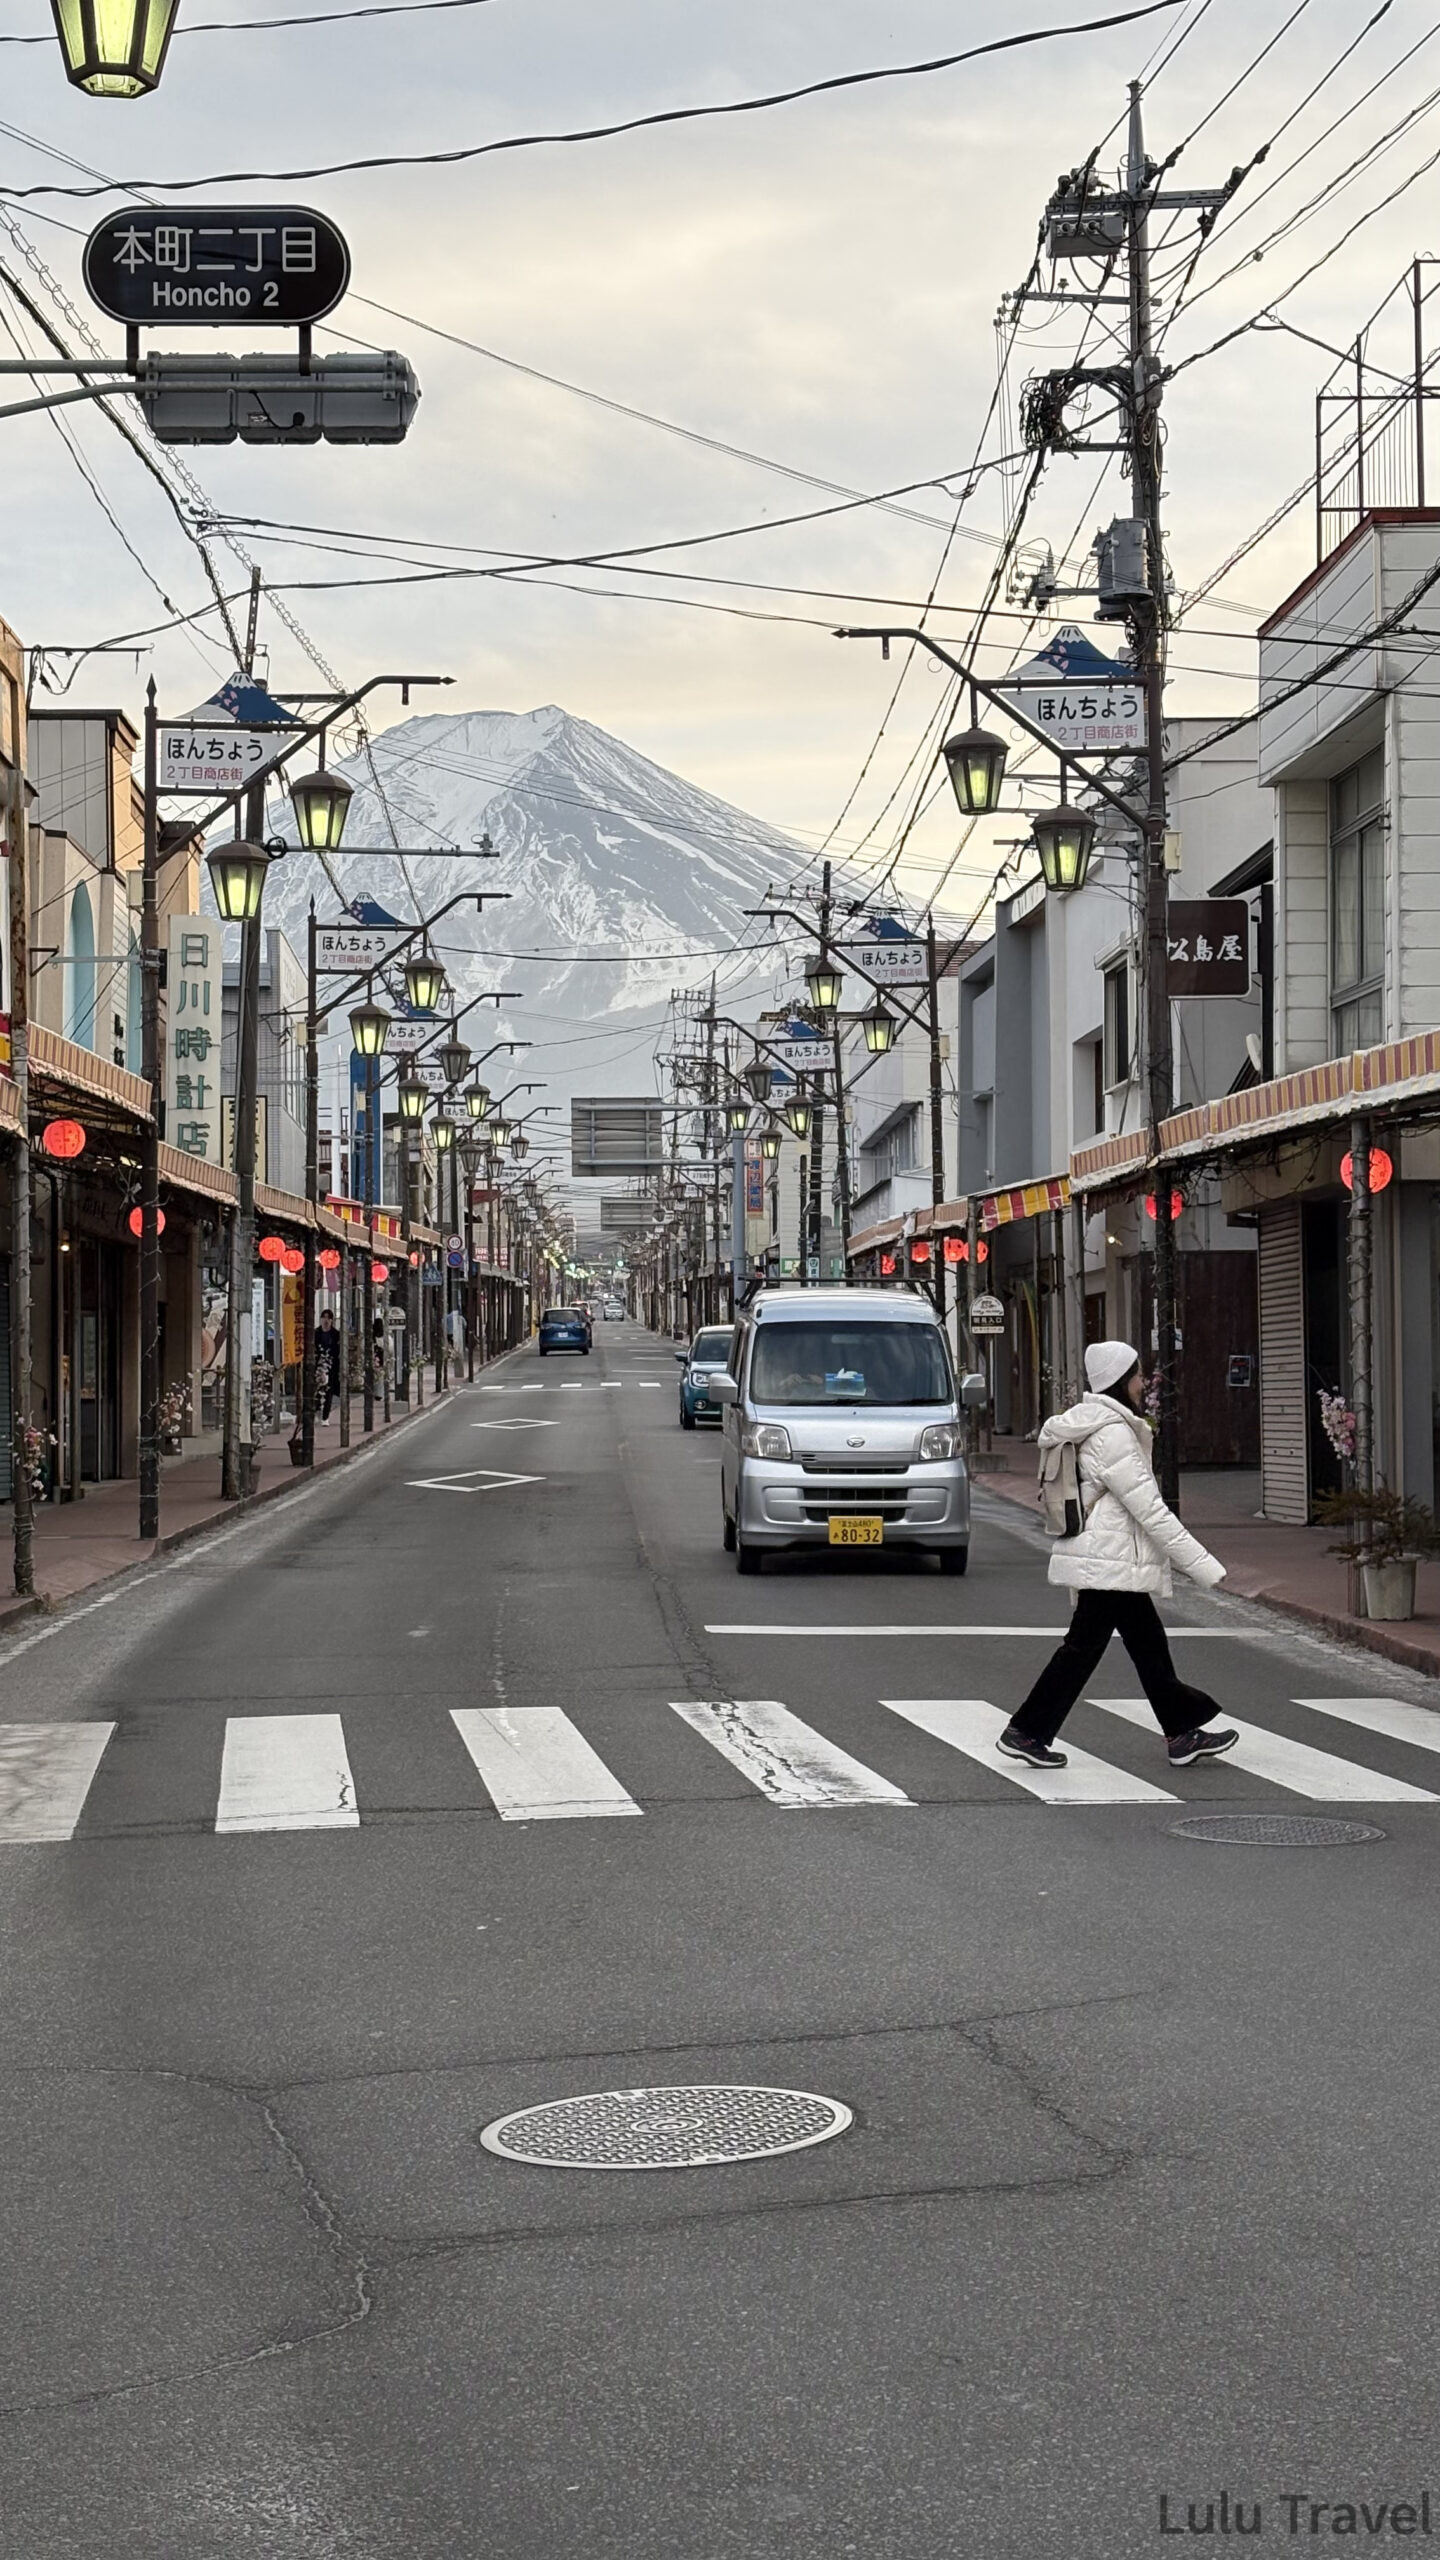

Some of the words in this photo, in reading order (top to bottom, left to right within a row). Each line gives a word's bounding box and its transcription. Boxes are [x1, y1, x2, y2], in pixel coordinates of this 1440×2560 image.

[112, 224, 317, 275] 本町二丁目
[152, 281, 251, 308] Honcho
[263, 281, 280, 307] 2
[1037, 694, 1139, 721] ほんちょう
[166, 736, 264, 762] ほんちょう
[321, 935, 387, 952] ほんちょう
[861, 950, 923, 967] ほんちょう
[387, 1025, 427, 1039] んちょう
[784, 1044, 832, 1059] ほんちょう
[841, 1528, 880, 1543] 80-32
